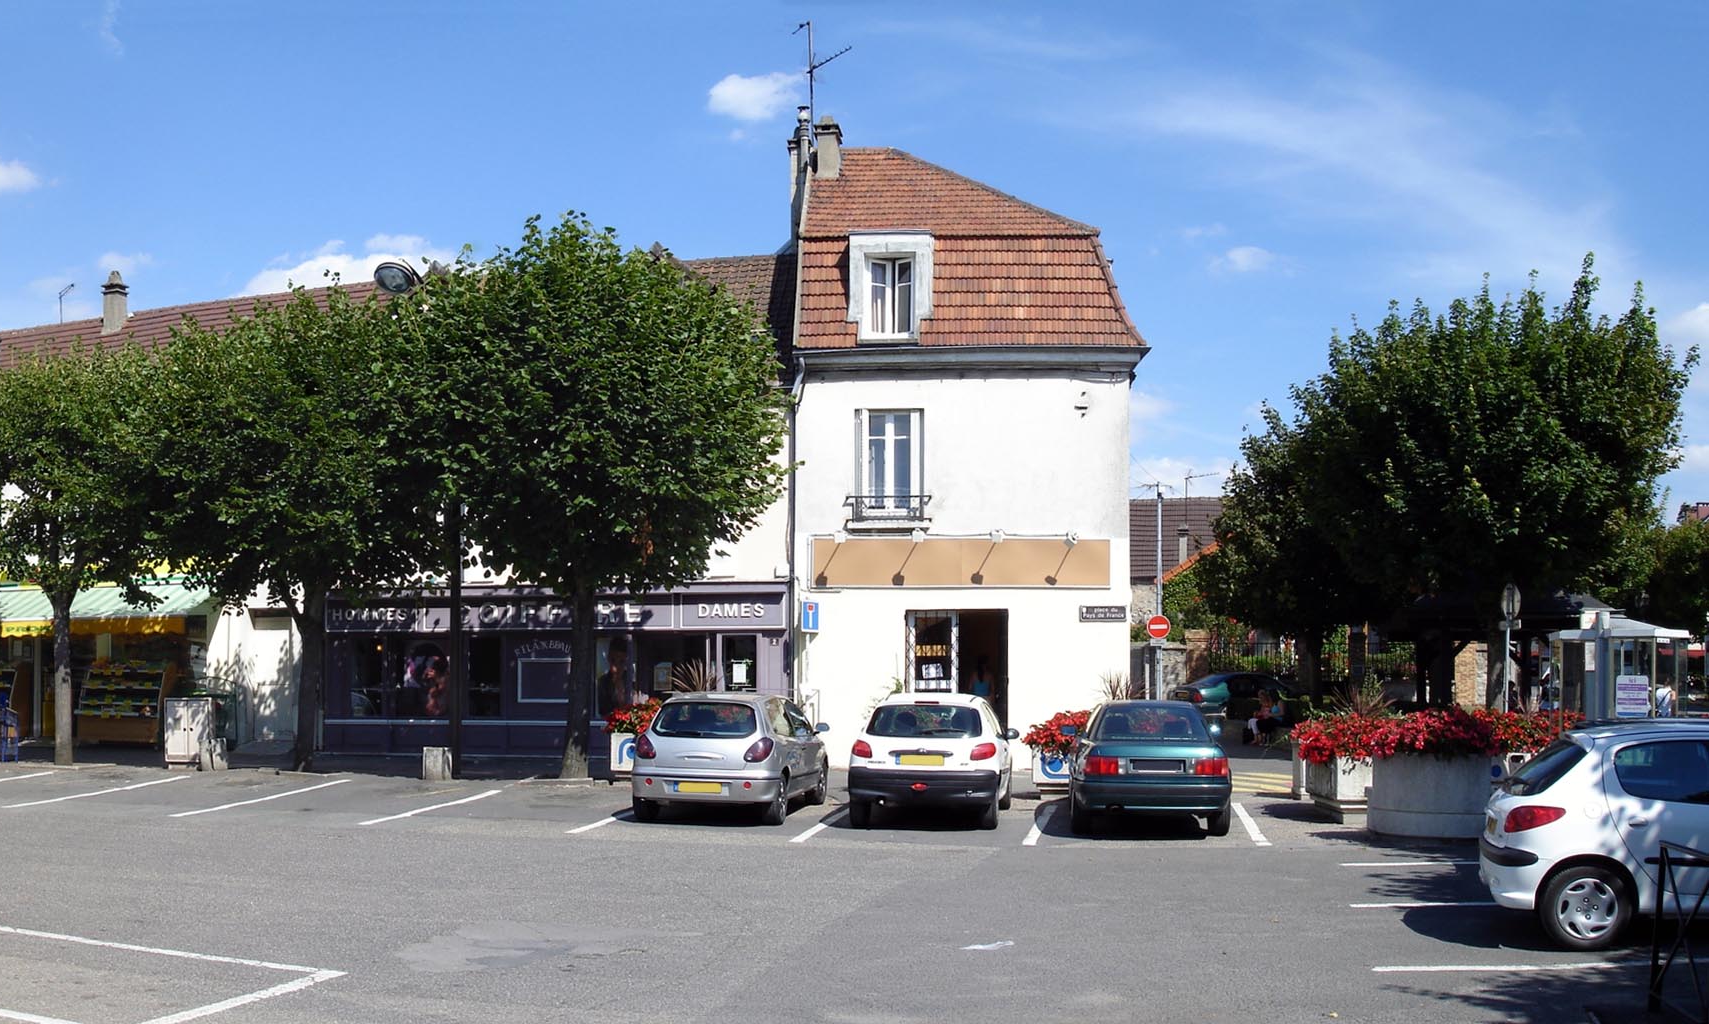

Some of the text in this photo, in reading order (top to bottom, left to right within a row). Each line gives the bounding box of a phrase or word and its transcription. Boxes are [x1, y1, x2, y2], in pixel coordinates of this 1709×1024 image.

[332, 607, 408, 622] HOMMES
[458, 601, 643, 624] COIFFRE
[698, 603, 765, 618] DAMES
